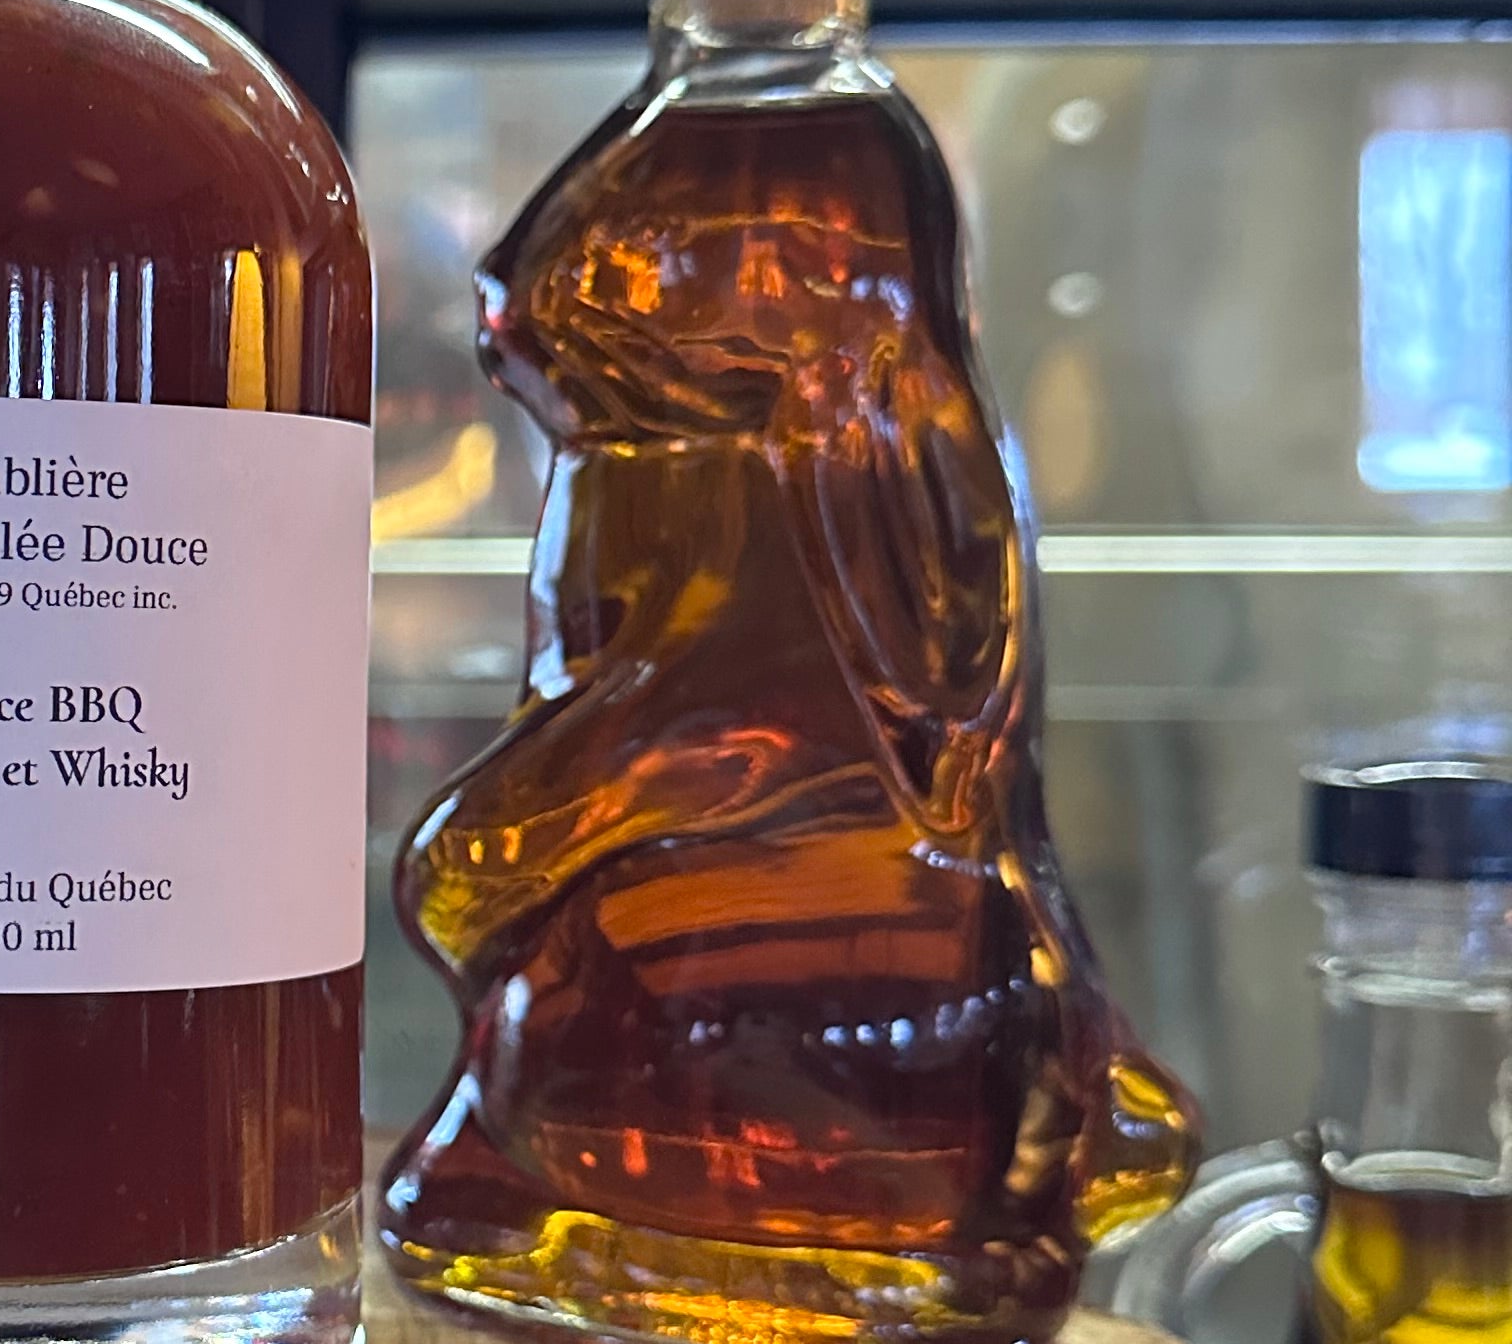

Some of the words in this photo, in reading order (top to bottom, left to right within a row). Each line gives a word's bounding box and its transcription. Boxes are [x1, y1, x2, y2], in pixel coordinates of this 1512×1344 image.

[80, 524, 208, 567] Douce
[21, 580, 126, 612] Québec
[132, 584, 177, 610] inc.
[49, 685, 146, 735] BBQ
[1, 759, 40, 787] et
[49, 745, 189, 801] Whisky
[48, 869, 173, 910] Québec
[32, 919, 78, 952] ml
